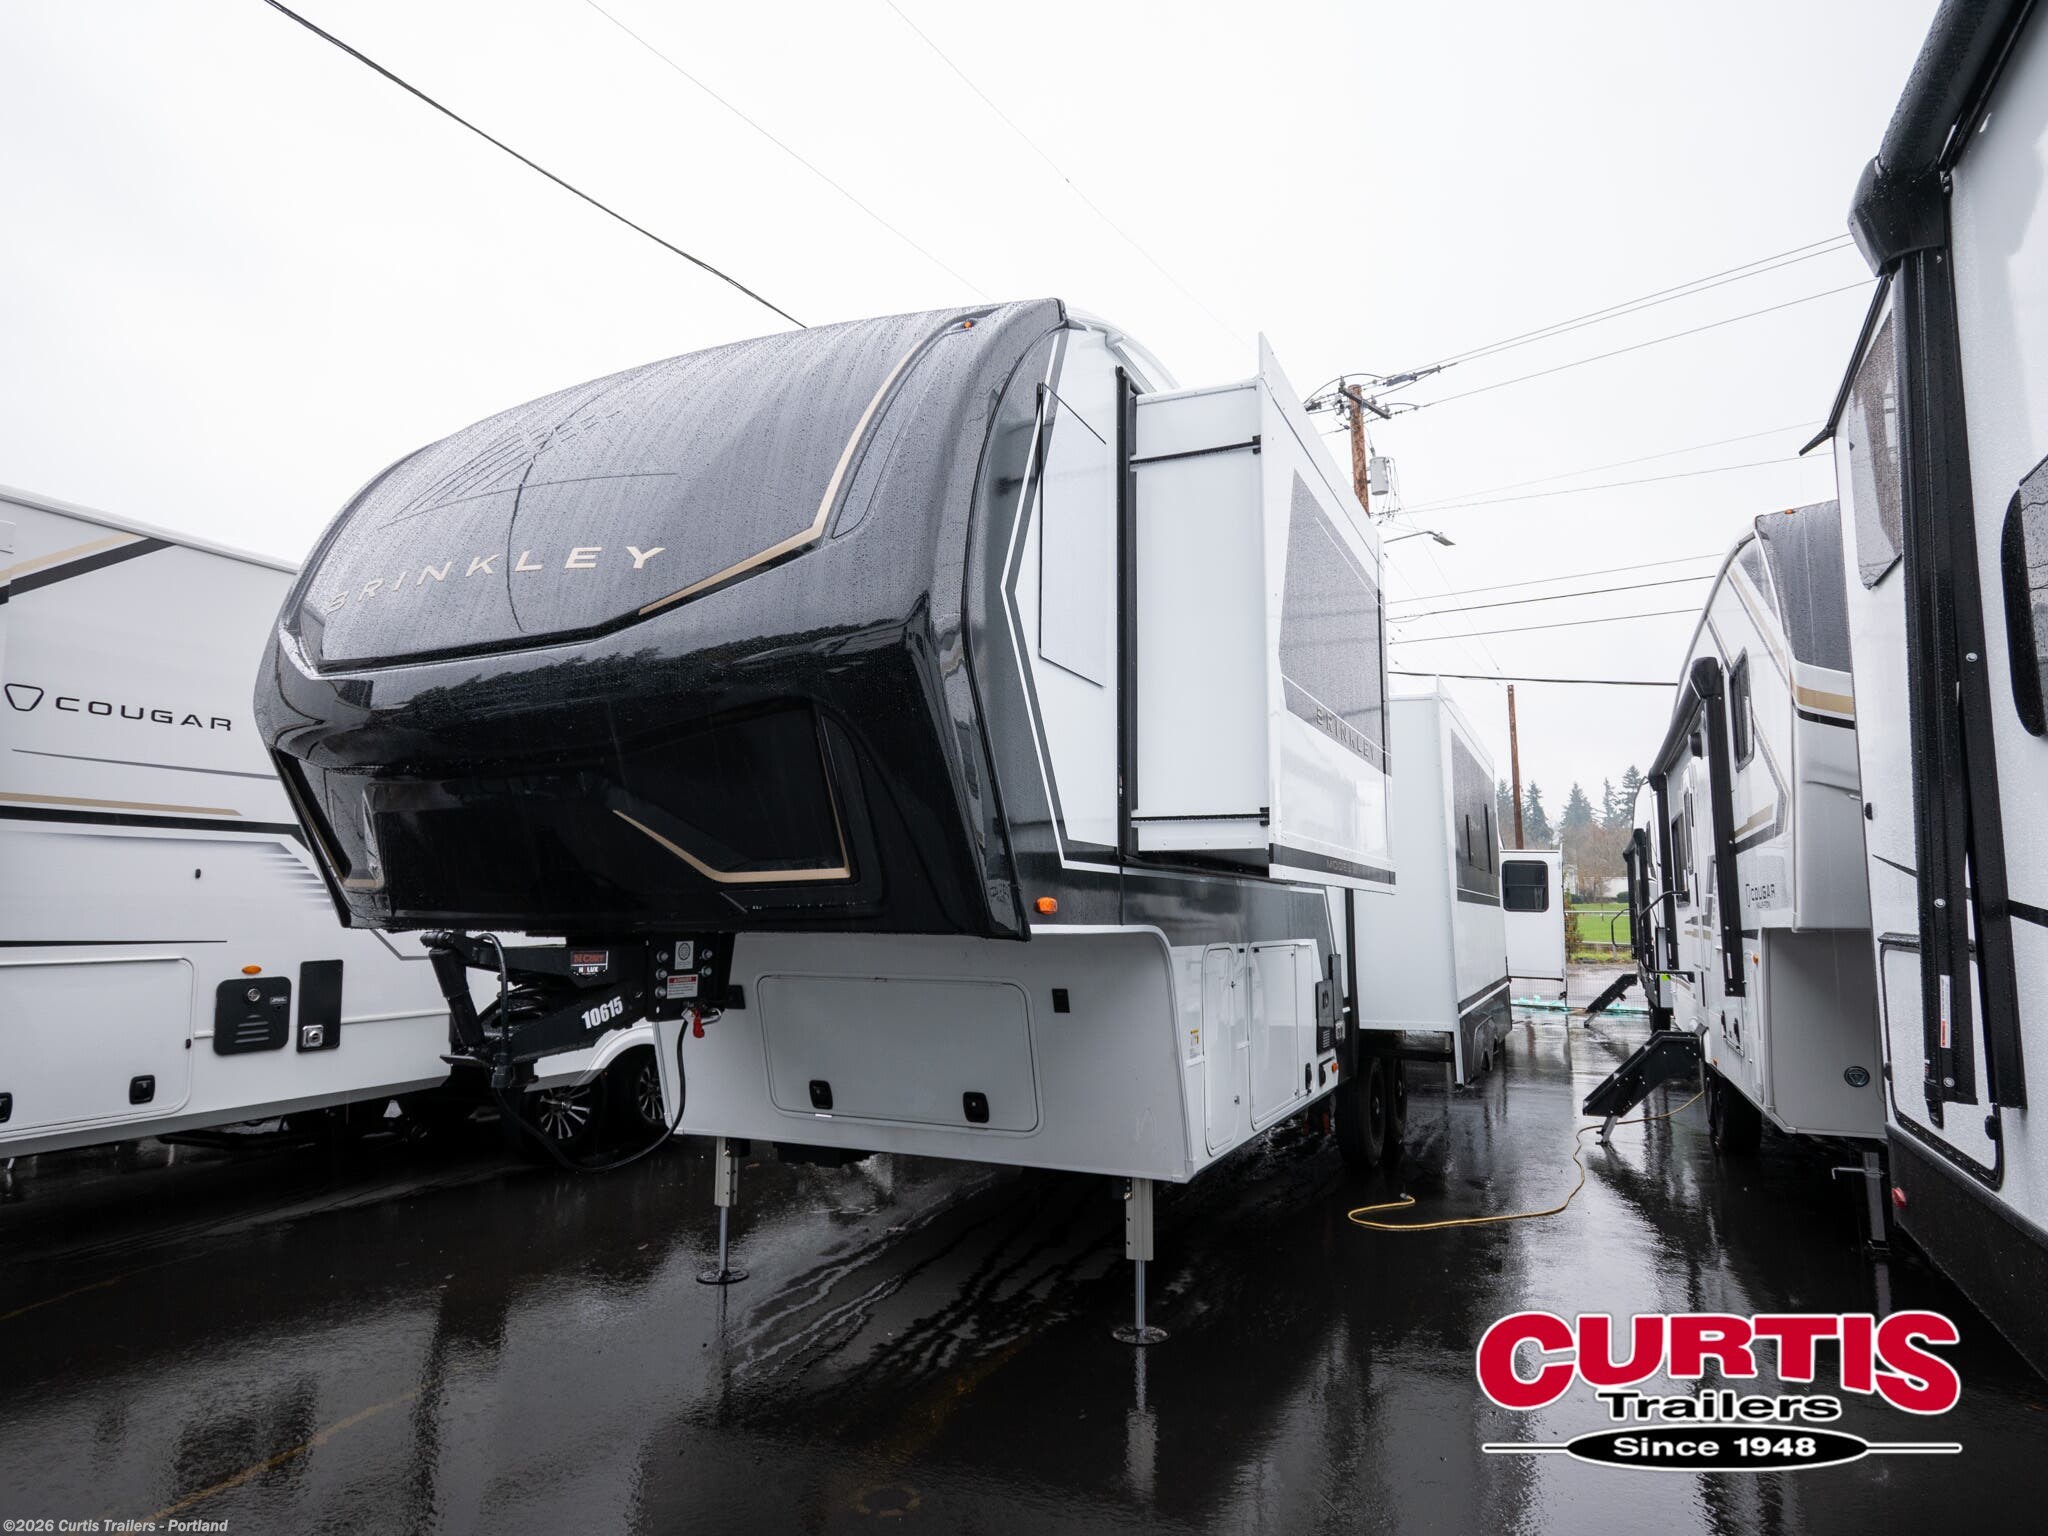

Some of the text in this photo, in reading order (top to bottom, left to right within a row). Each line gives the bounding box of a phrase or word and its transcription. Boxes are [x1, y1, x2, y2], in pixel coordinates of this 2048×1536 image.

[325, 546, 666, 615] BRINKLEY
[55, 696, 232, 732] COUGAR
[1316, 706, 1375, 761] BRINKLEY
[581, 996, 624, 1030] 10615
